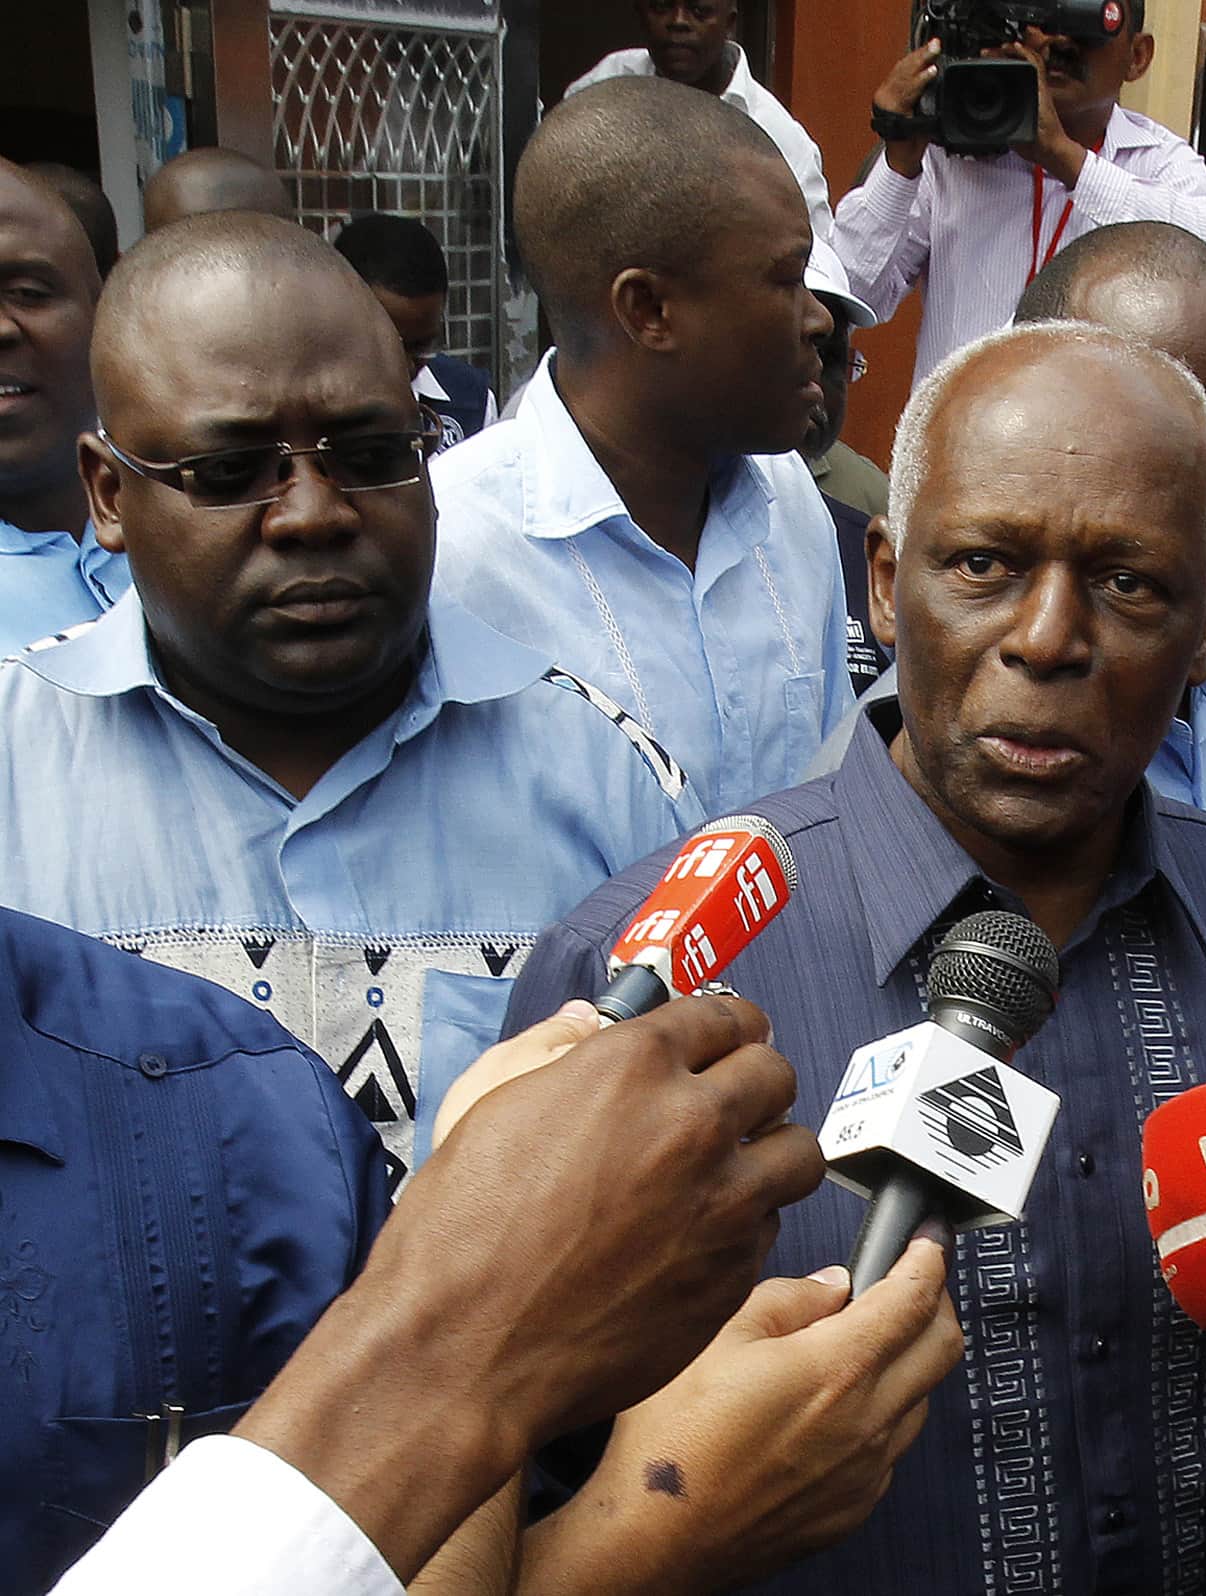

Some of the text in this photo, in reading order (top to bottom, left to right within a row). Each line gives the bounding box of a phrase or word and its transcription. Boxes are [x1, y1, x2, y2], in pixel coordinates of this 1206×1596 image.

[664, 838, 736, 883] rfi
[733, 852, 778, 932] rfi
[624, 909, 681, 944] rfi
[681, 923, 718, 986] rfi
